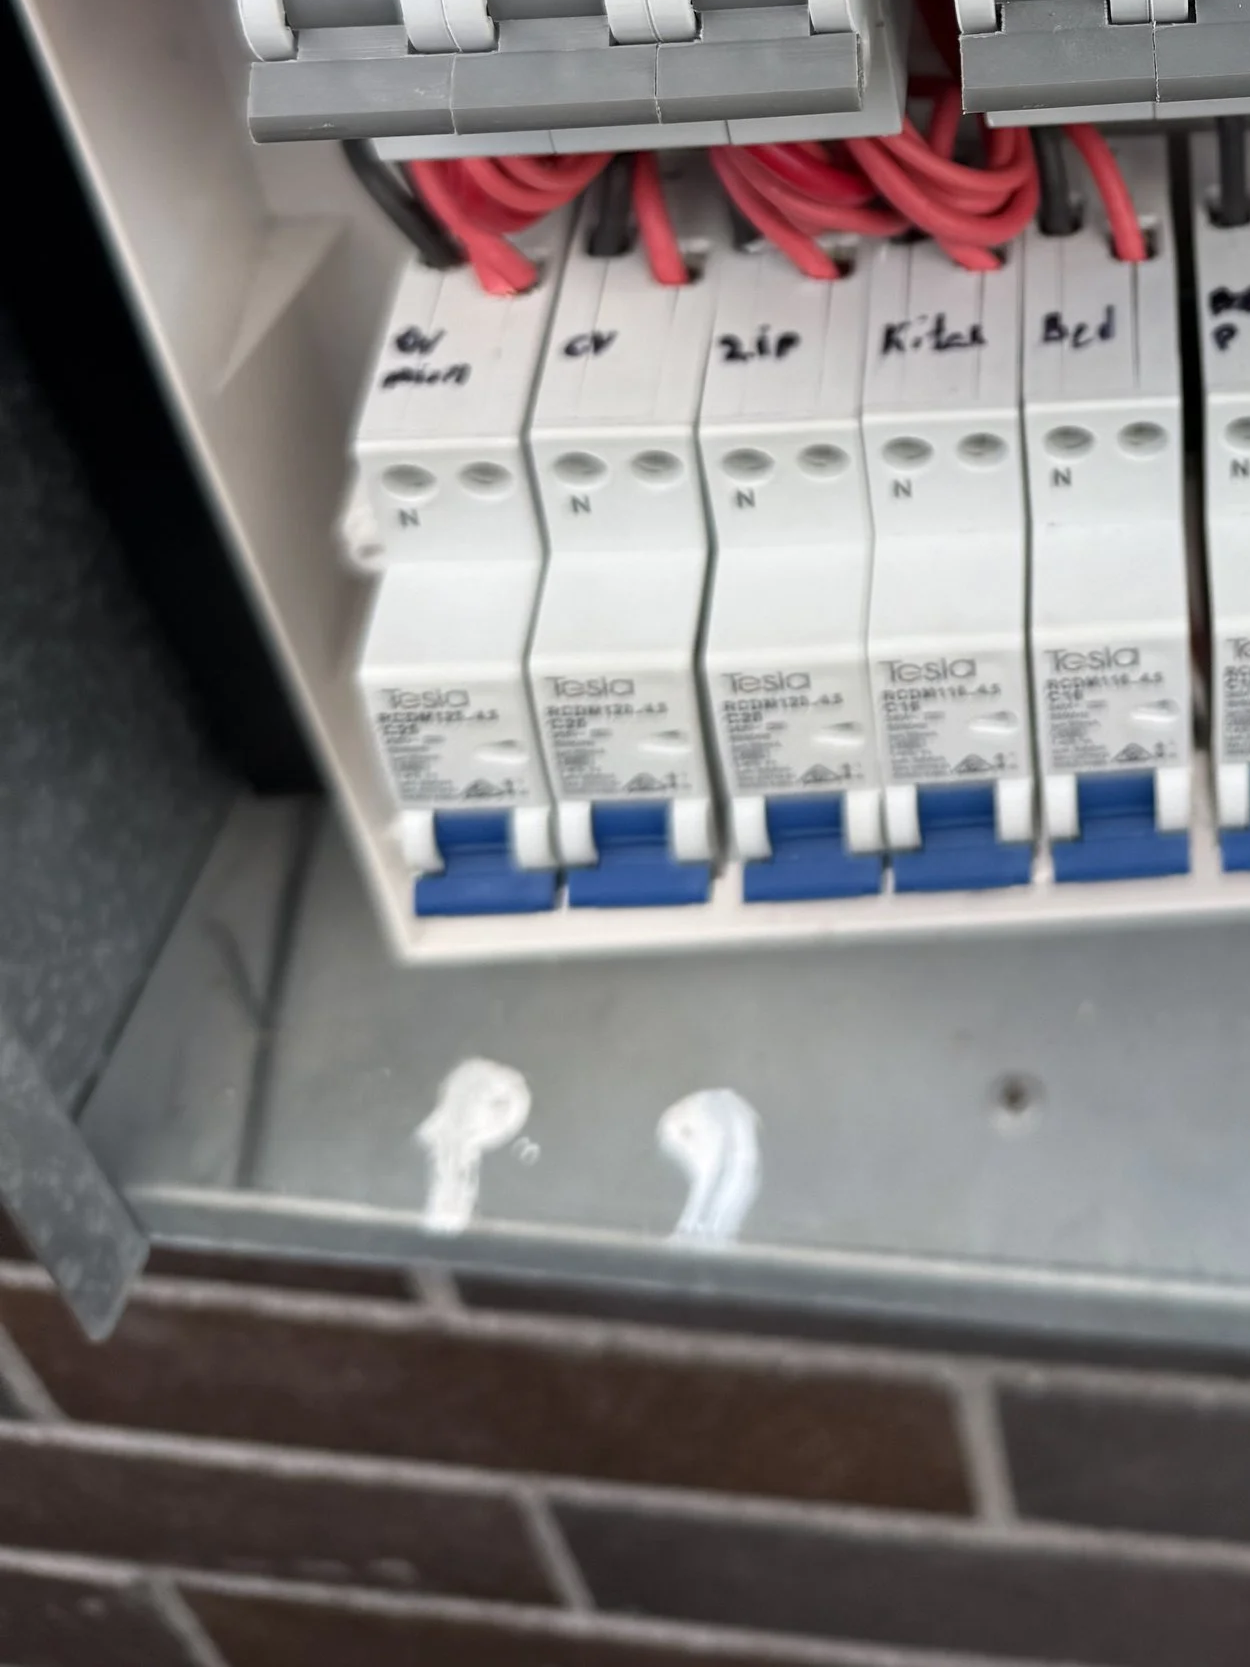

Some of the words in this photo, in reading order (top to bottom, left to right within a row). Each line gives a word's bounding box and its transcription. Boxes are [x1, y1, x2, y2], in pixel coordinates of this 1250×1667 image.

[1053, 468, 1073, 488] N
[893, 479, 913, 498] N
[570, 495, 591, 514] N
[735, 489, 756, 509] N
[398, 508, 420, 528] N
